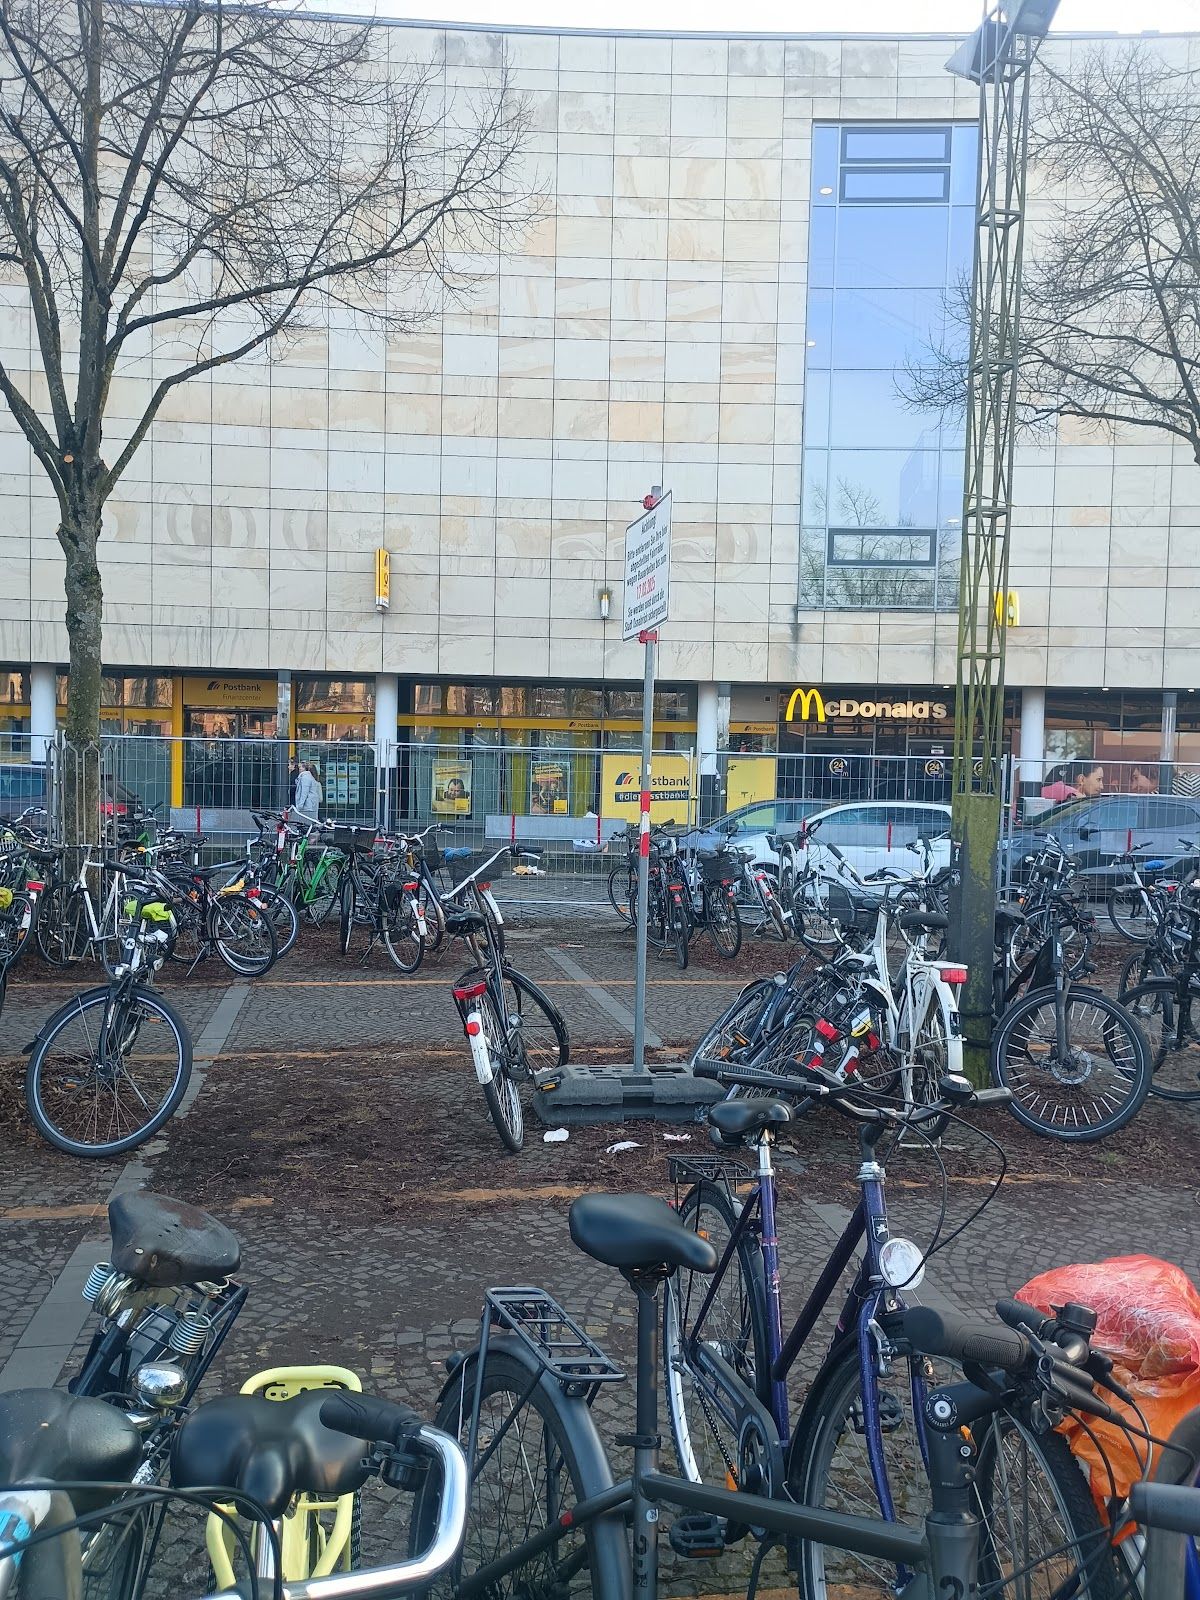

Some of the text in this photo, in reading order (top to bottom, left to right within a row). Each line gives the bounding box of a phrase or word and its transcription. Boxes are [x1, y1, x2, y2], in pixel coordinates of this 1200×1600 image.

[627, 574, 637, 586] wegen
[223, 683, 261, 691] Postbank
[785, 688, 947, 722] McDonald's
[833, 761, 844, 769] 24
[929, 763, 940, 771] 24
